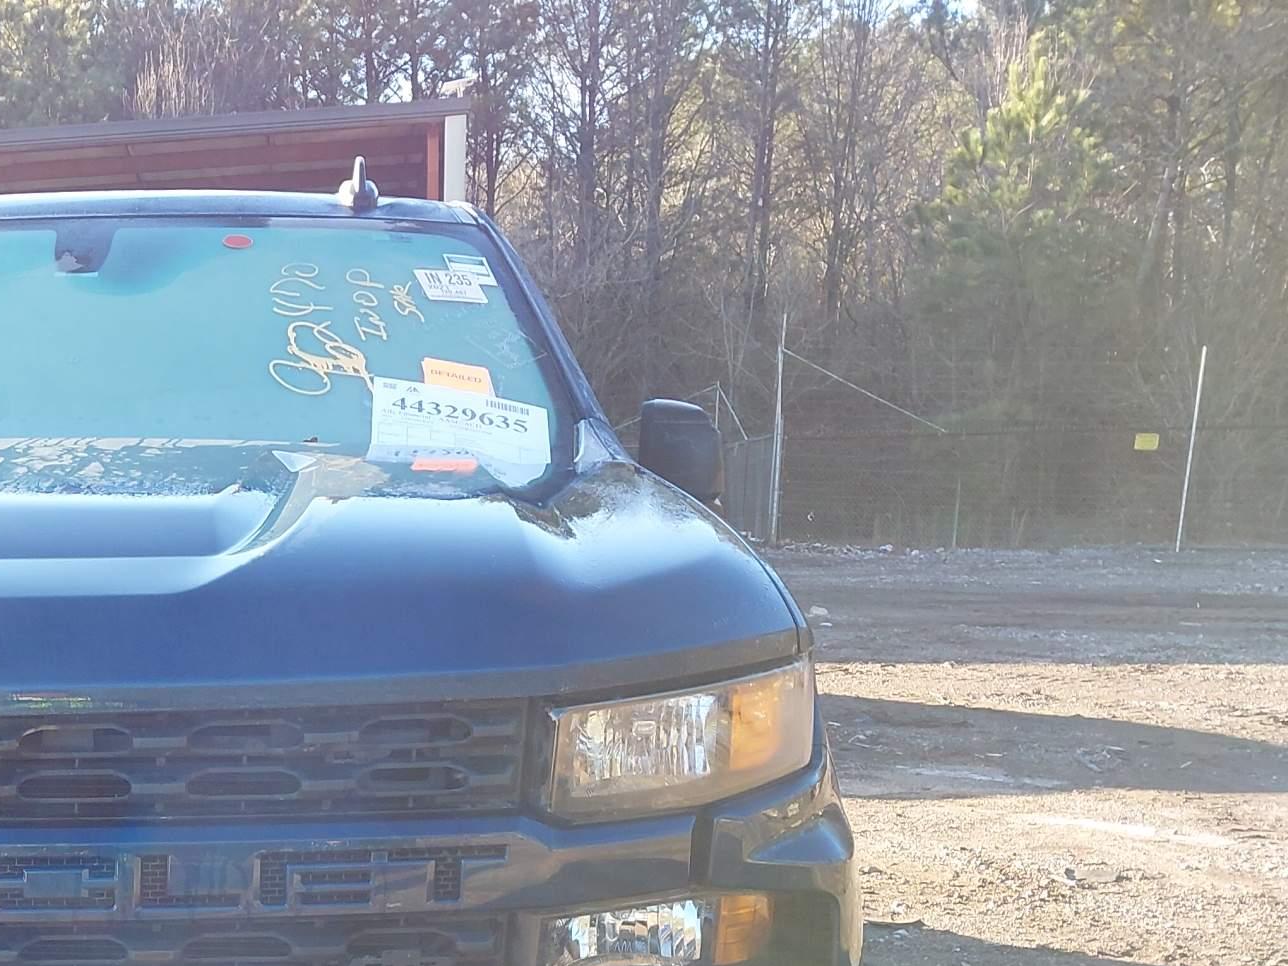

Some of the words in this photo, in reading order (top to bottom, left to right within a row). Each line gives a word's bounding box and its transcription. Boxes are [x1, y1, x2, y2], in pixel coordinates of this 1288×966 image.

[424, 271, 443, 285] IN
[444, 271, 473, 287] 235
[391, 396, 529, 434] 44329635
